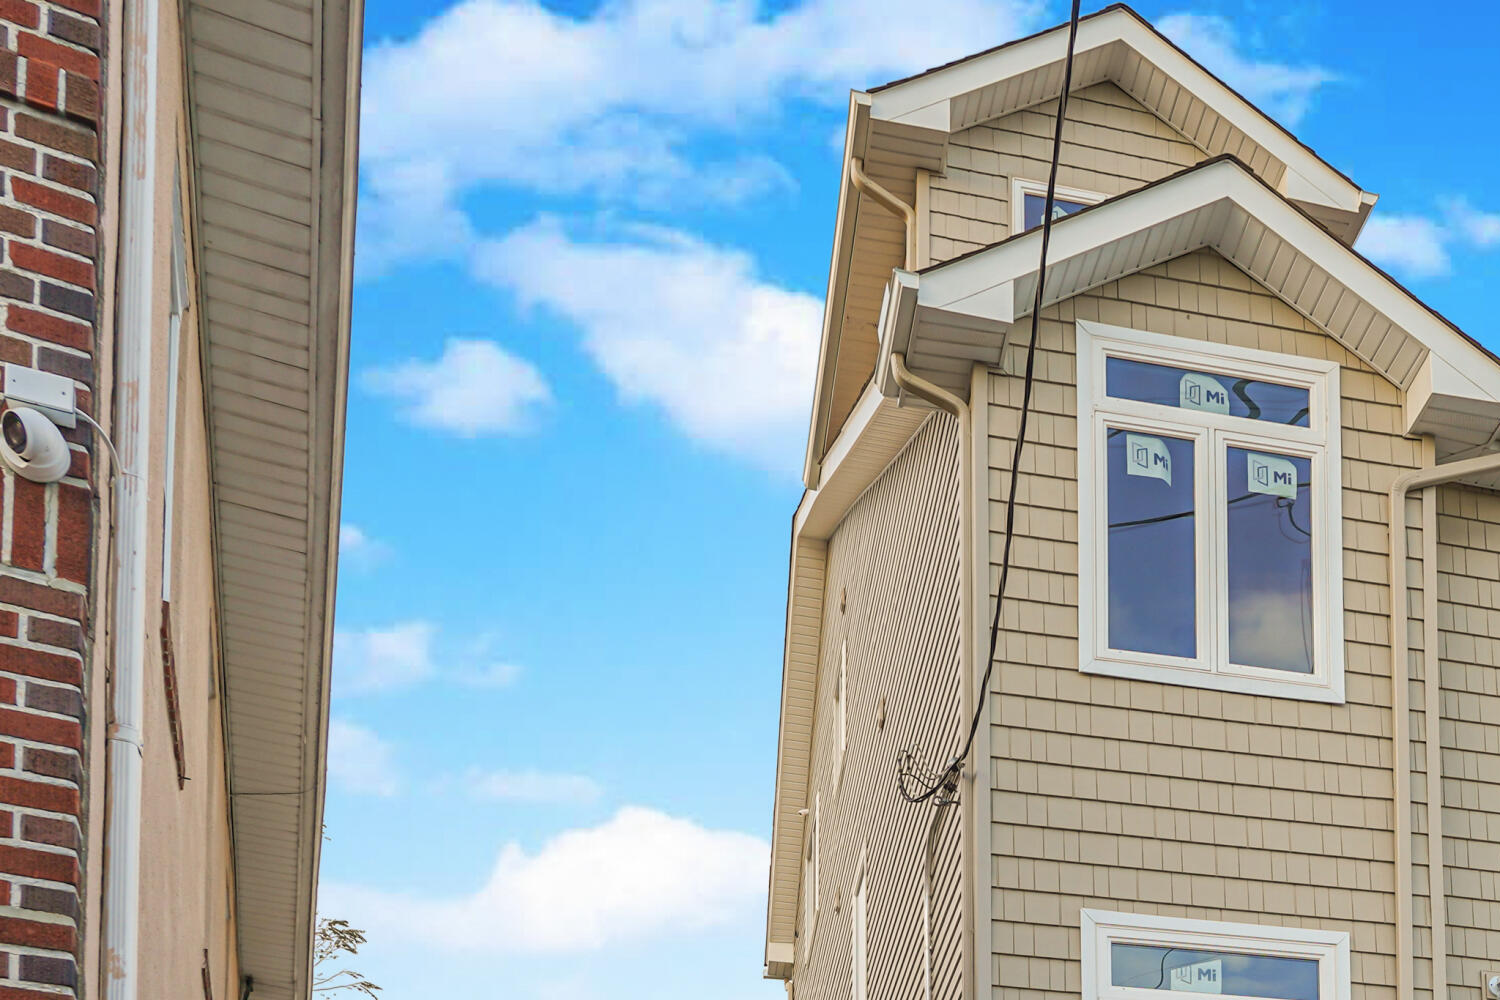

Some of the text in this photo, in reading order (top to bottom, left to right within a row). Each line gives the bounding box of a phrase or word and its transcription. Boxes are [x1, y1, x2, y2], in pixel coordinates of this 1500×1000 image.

[1206, 389, 1225, 406] Mi
[1153, 452, 1169, 472] Mi
[1273, 470, 1292, 486] Mi
[1197, 967, 1217, 983] Mi
